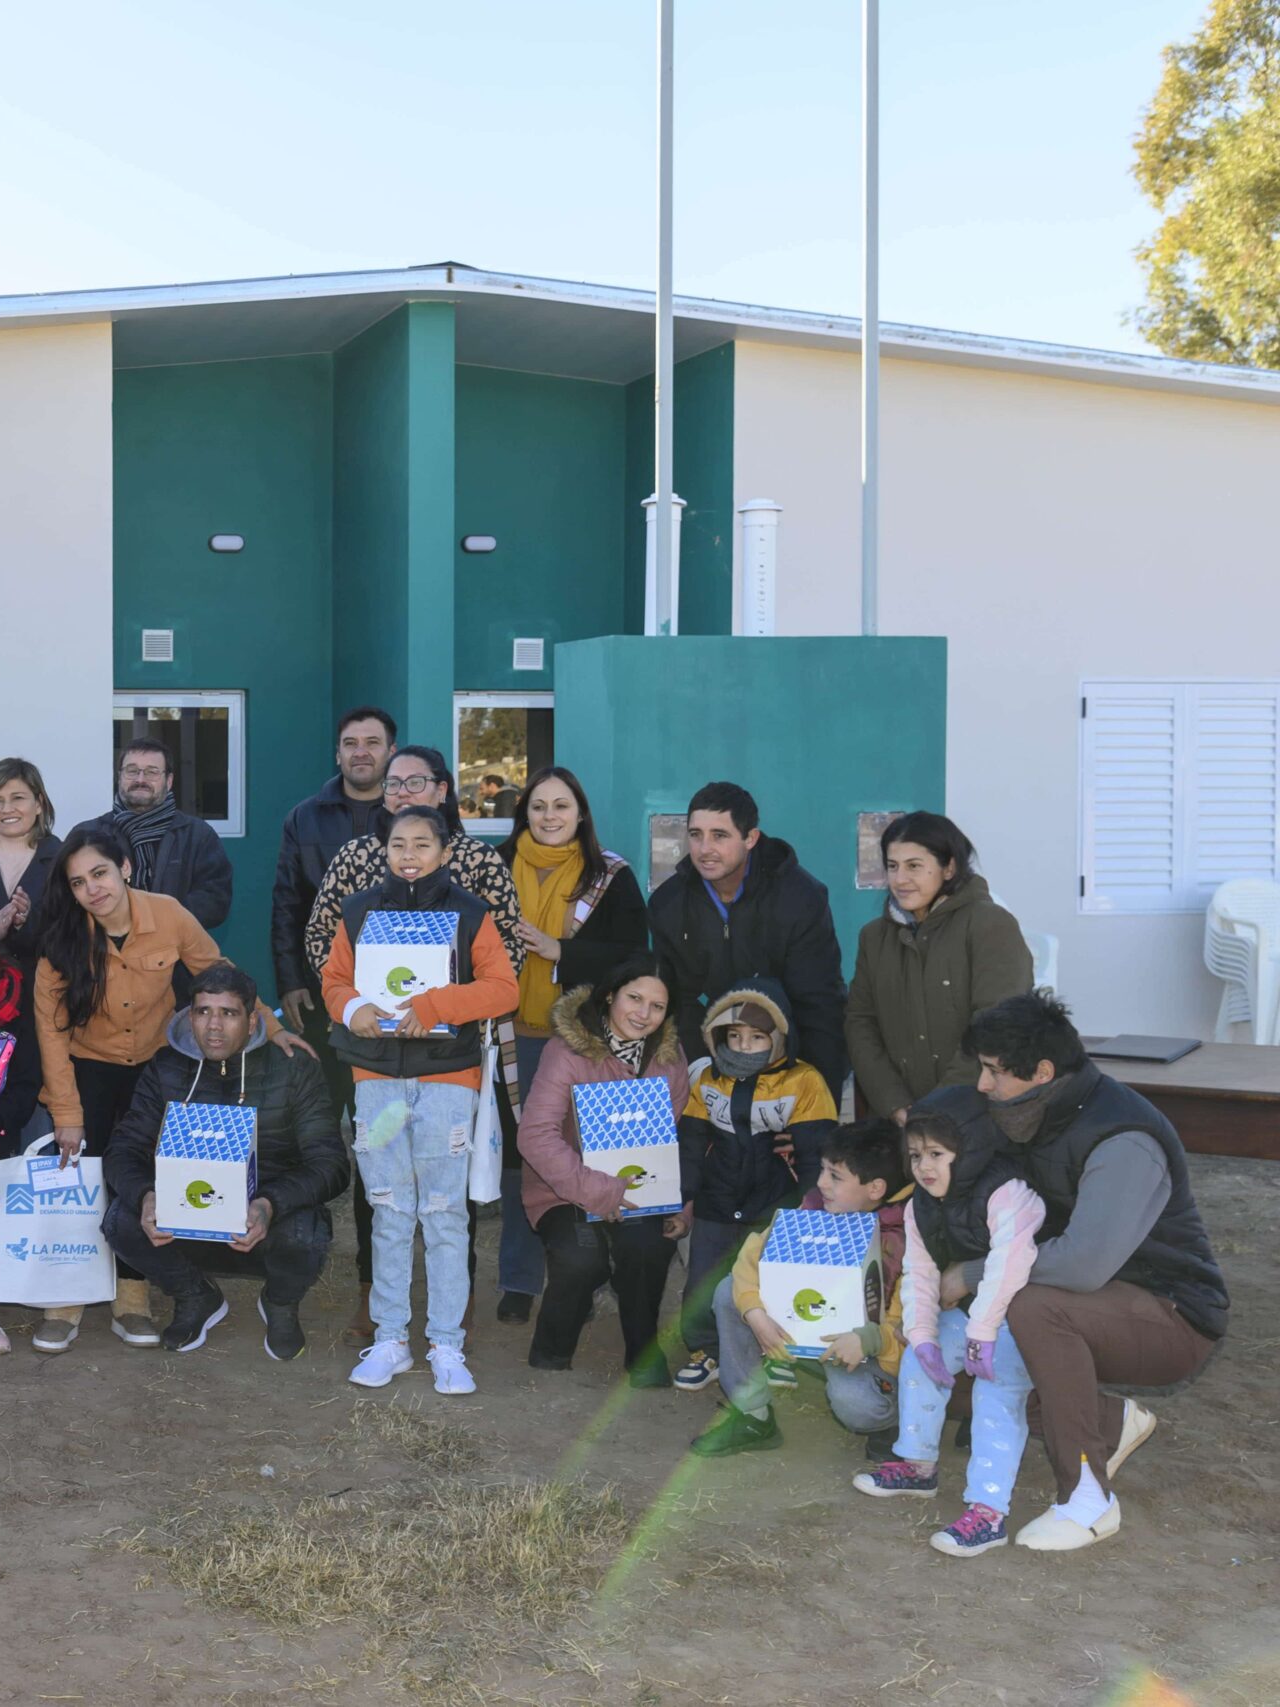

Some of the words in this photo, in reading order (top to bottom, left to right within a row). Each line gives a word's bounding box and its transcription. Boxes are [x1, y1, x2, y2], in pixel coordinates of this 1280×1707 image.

[39, 1185, 100, 1206] IPAV
[31, 1244, 48, 1255] LA
[52, 1243, 99, 1255] PAMPA
